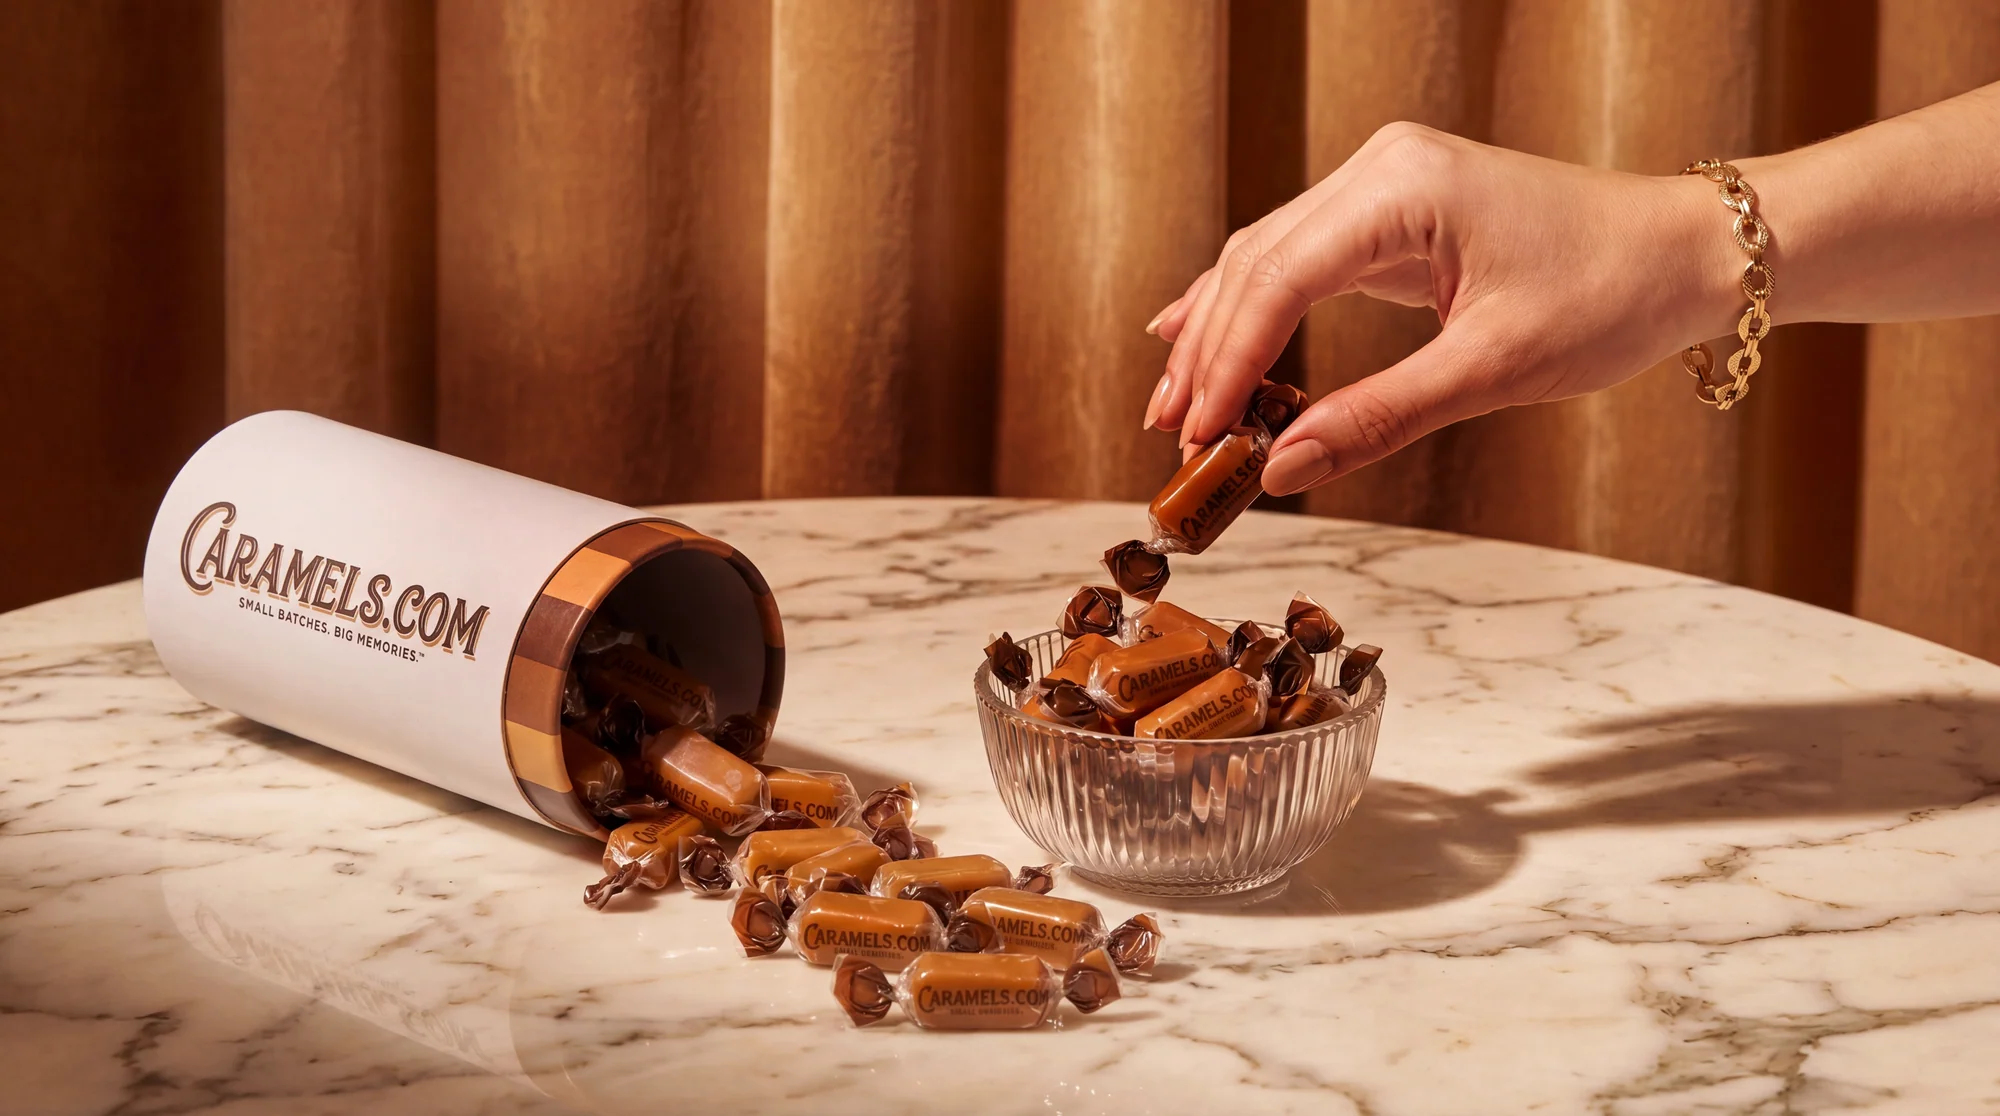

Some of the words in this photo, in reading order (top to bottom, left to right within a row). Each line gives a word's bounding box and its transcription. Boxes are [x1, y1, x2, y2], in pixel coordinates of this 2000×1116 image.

[1180, 449, 1269, 541] CARAMELS.CO
[180, 501, 490, 661] CARAMELS.COM
[239, 596, 274, 618] SMALL
[277, 608, 330, 635] BATCHES.
[334, 625, 353, 642] BIG
[1118, 653, 1219, 703] CARAMELS.CO
[804, 923, 931, 953] CARAMELS.COM
[918, 985, 1049, 1013] CARAMELS.COM
